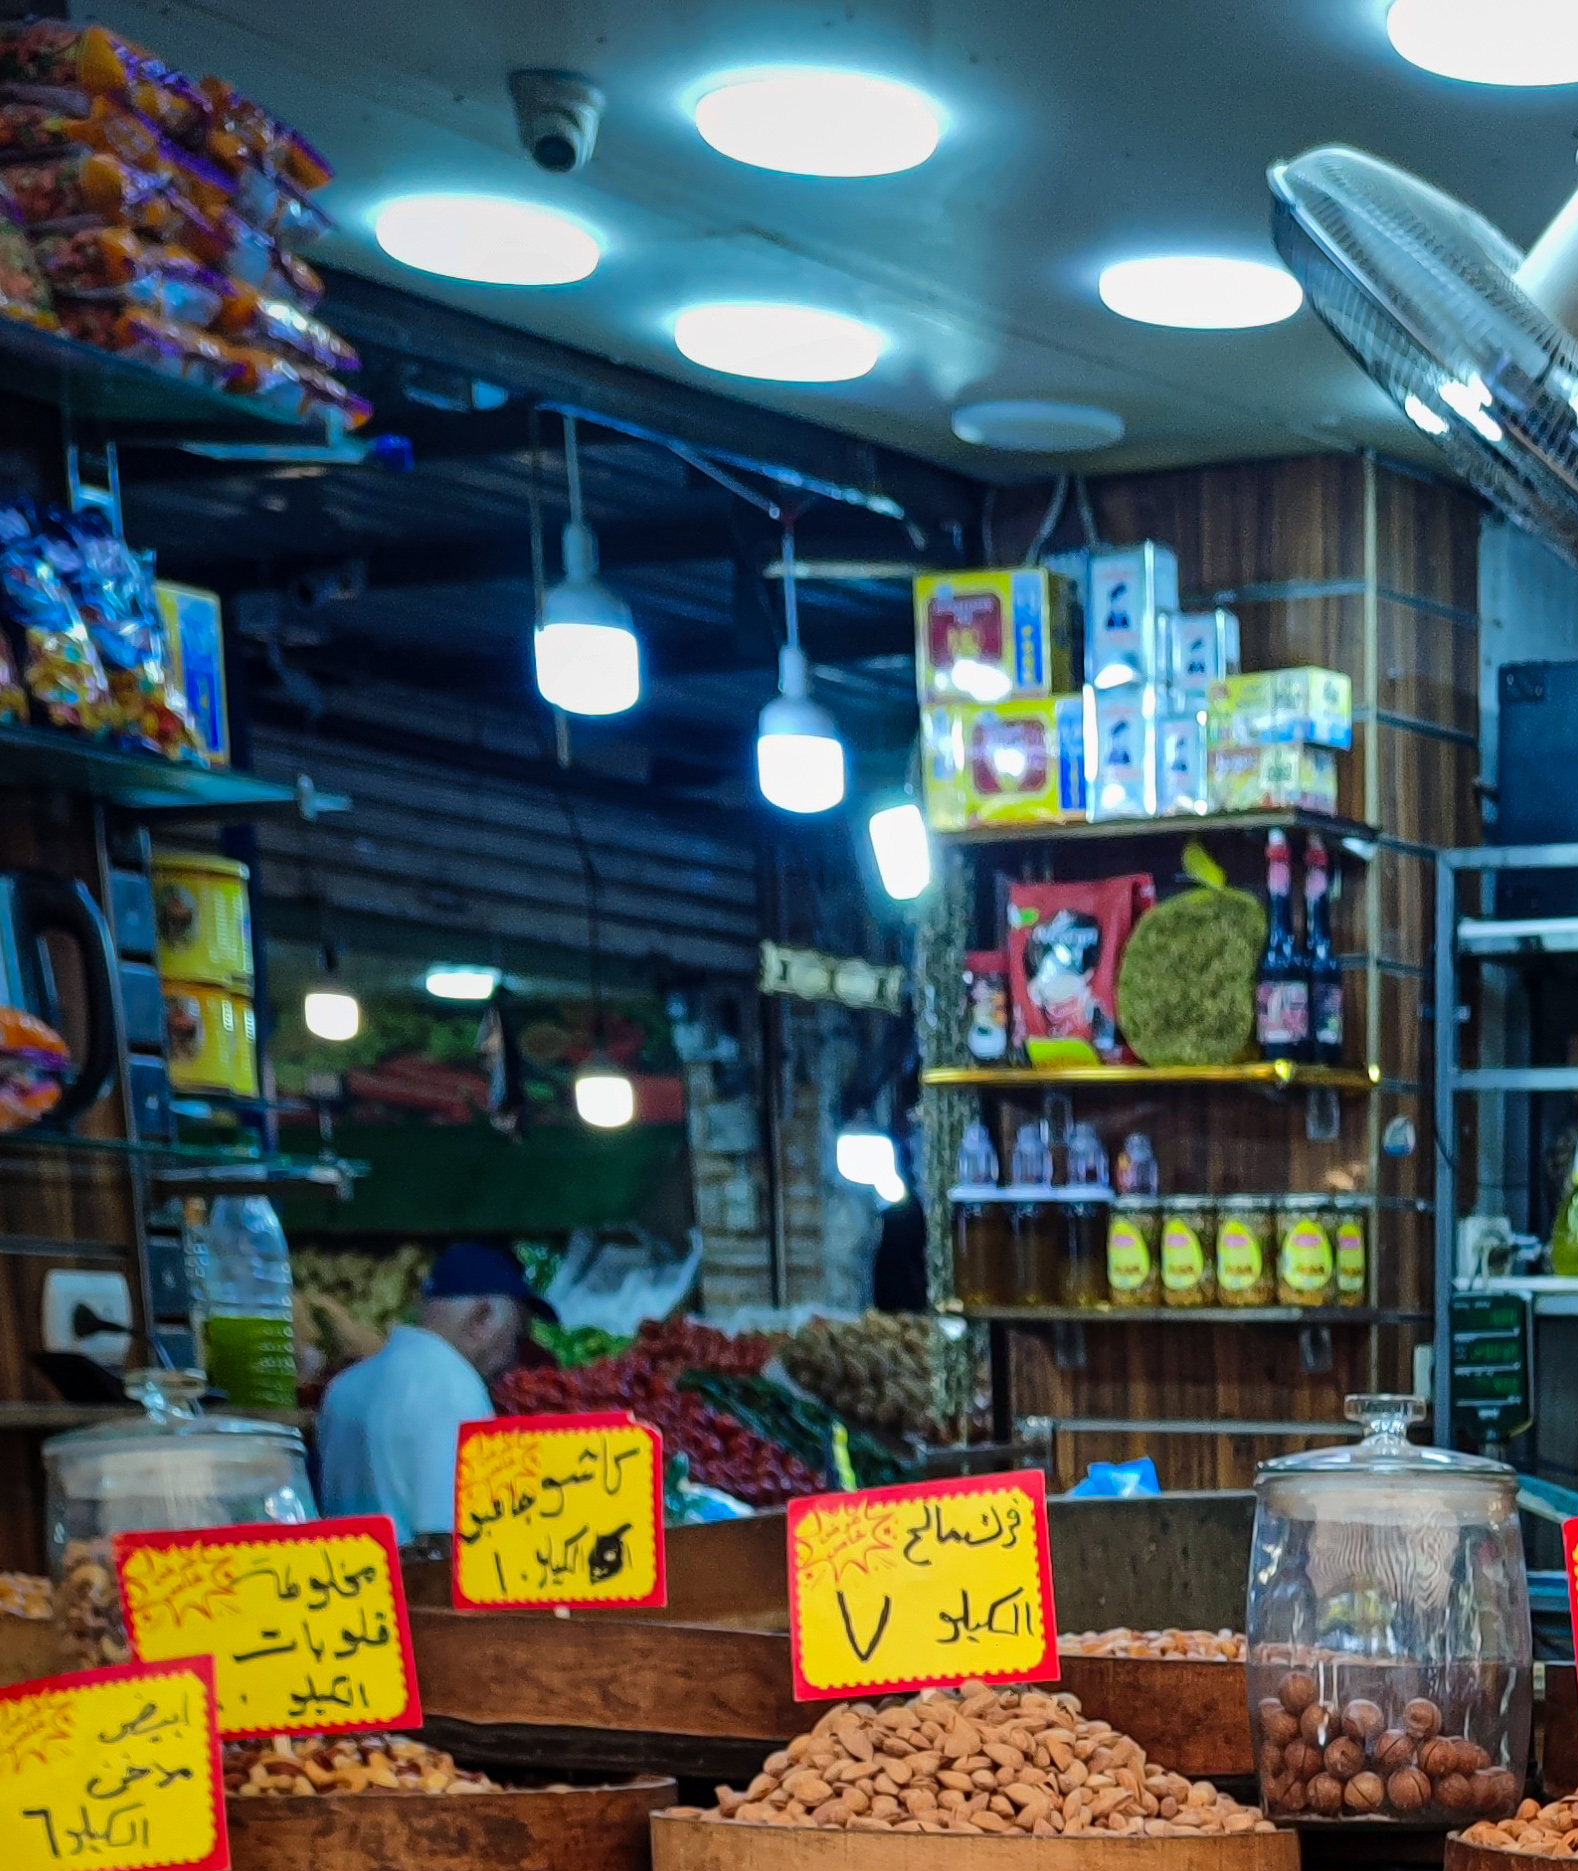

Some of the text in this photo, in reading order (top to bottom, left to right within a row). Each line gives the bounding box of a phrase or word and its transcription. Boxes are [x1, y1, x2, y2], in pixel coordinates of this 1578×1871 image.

[936, 1586, 1034, 1643] الكيلو
[287, 1674, 370, 1717] الكيلو
[65, 1803, 151, 1856] الكيلو
